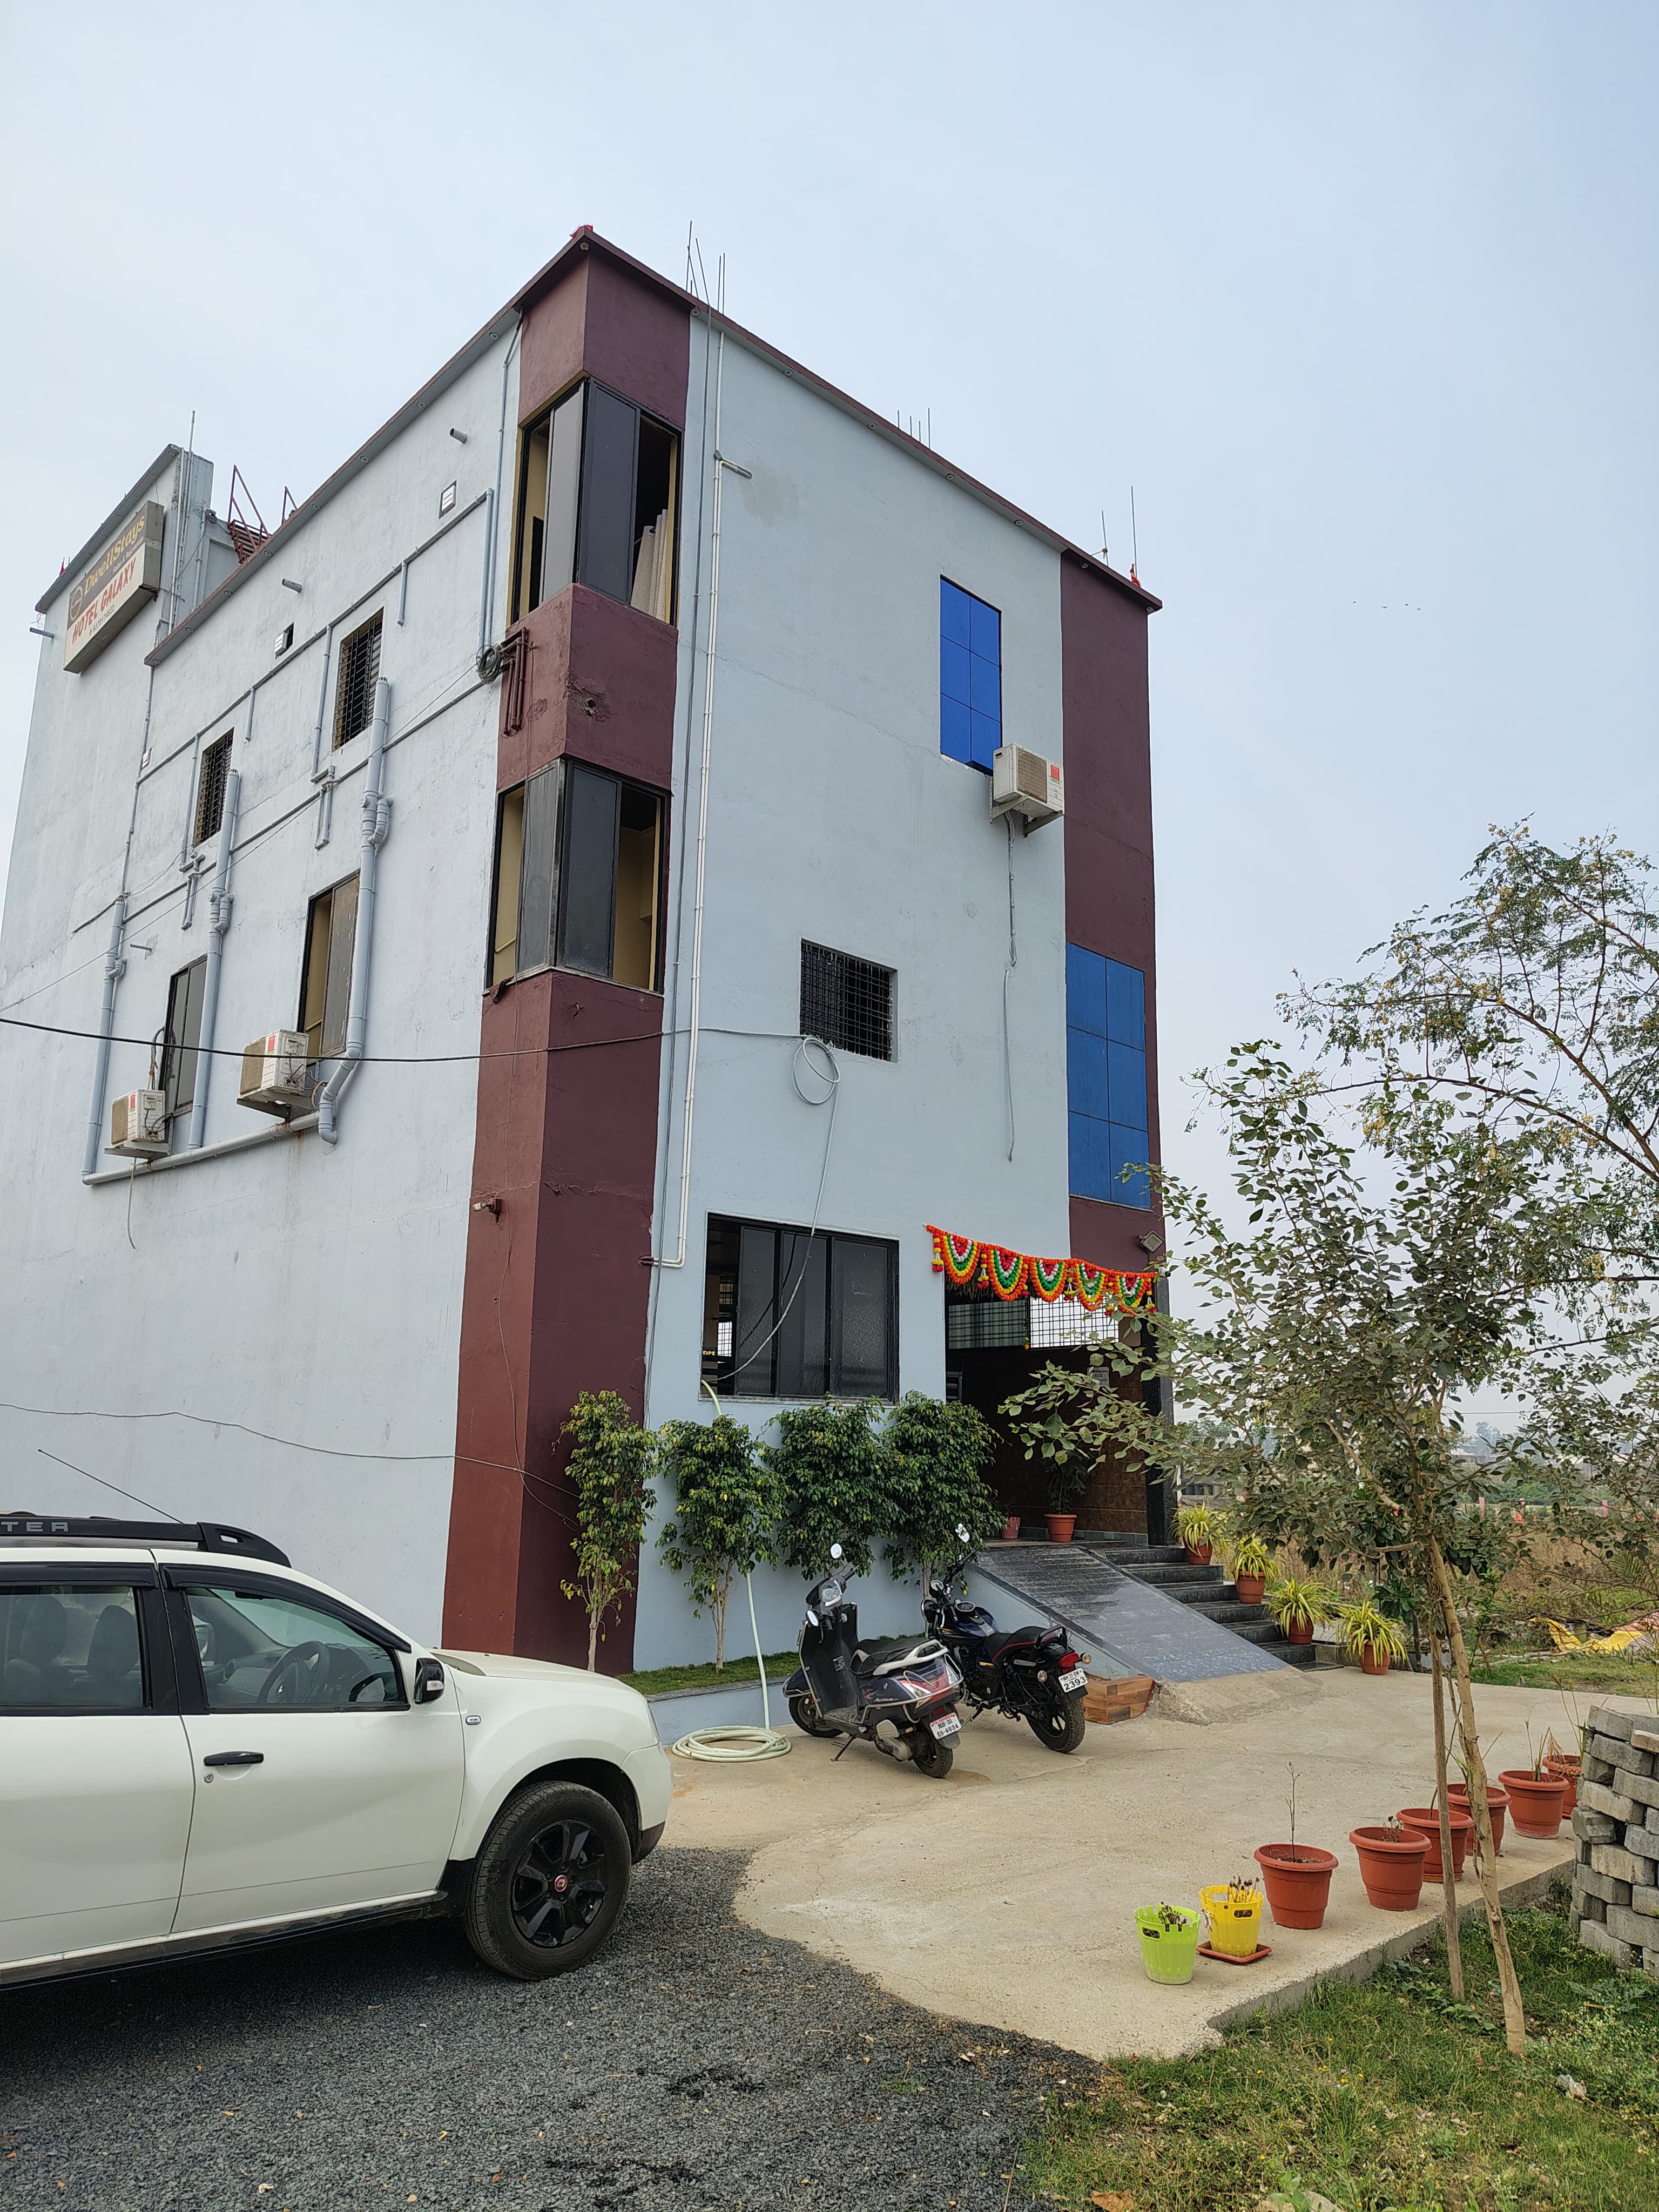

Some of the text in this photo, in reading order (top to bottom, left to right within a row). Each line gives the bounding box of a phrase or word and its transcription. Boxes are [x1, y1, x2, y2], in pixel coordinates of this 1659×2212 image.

[84, 515, 145, 596] DwellStays
[72, 557, 137, 644] HOTEL GALAXY
[1, 1521, 69, 1532] TER
[1064, 1676, 1085, 1691] 2393
